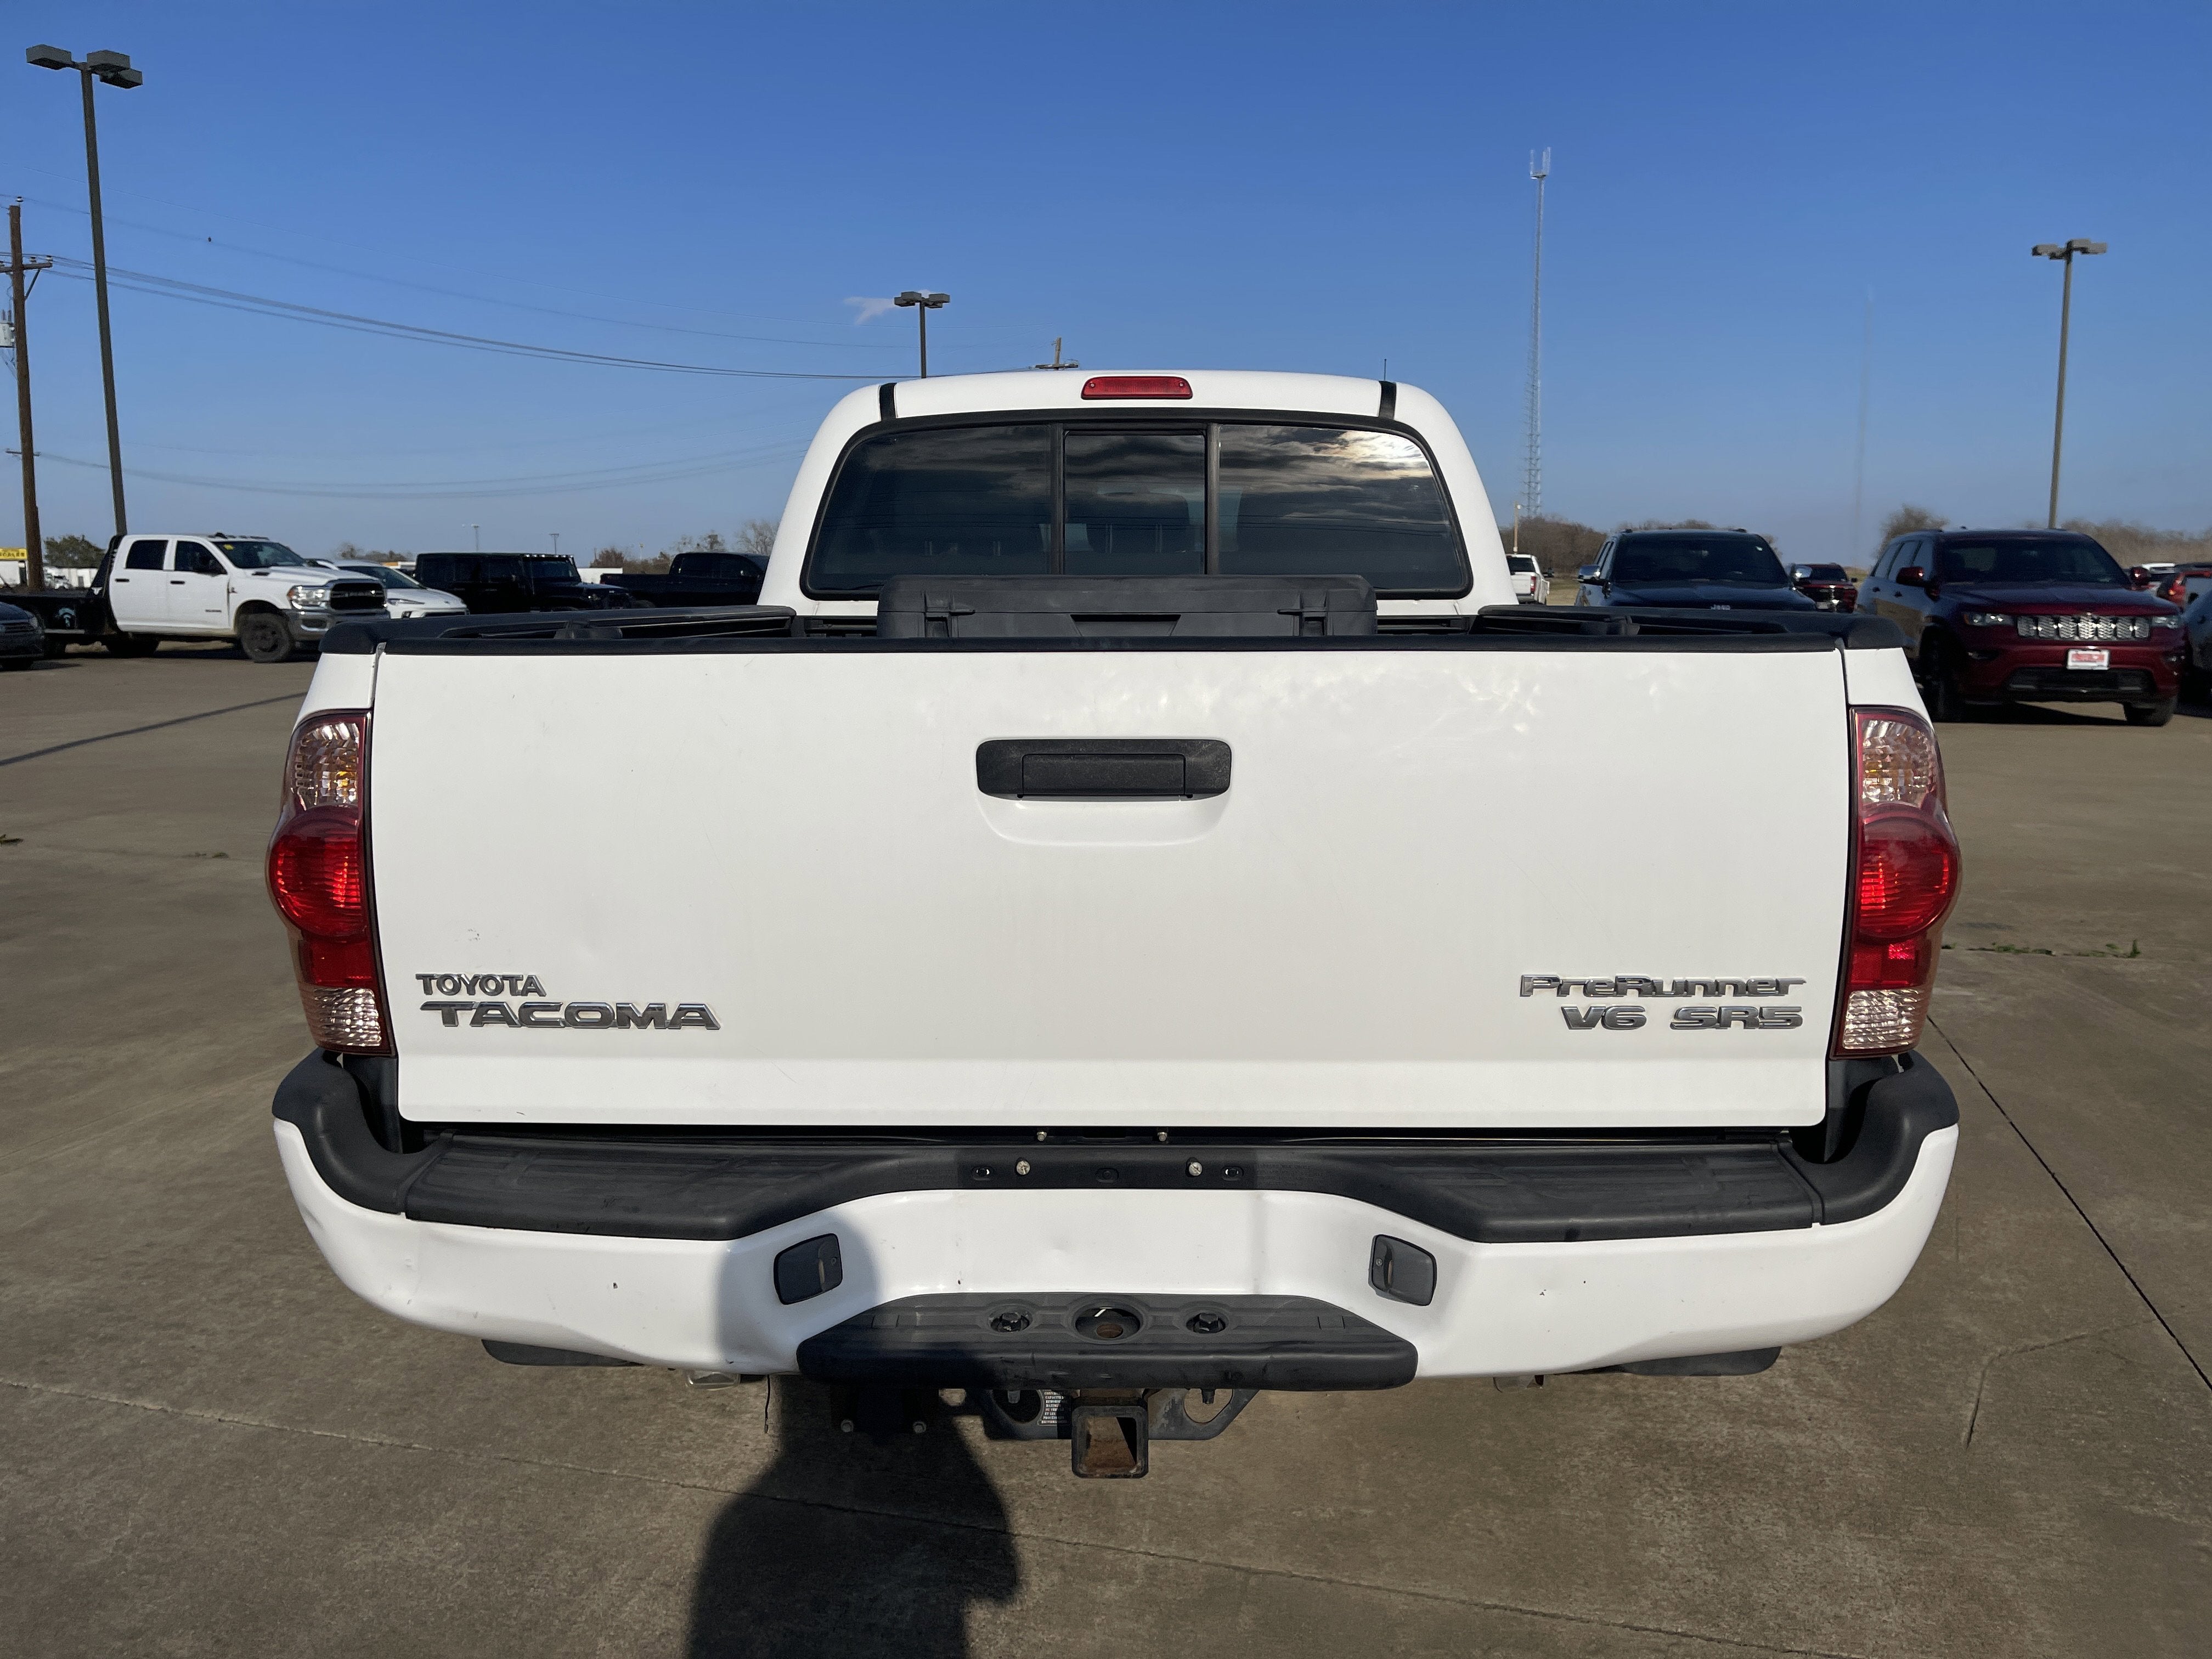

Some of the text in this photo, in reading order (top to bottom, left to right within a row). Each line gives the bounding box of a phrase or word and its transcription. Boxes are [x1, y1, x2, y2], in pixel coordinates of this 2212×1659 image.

[415, 973, 546, 997] TOYOTA
[1520, 974, 1807, 997] PreRunner
[420, 1001, 721, 1030] TACOMA
[1561, 1006, 1803, 1029] V6 SR5
